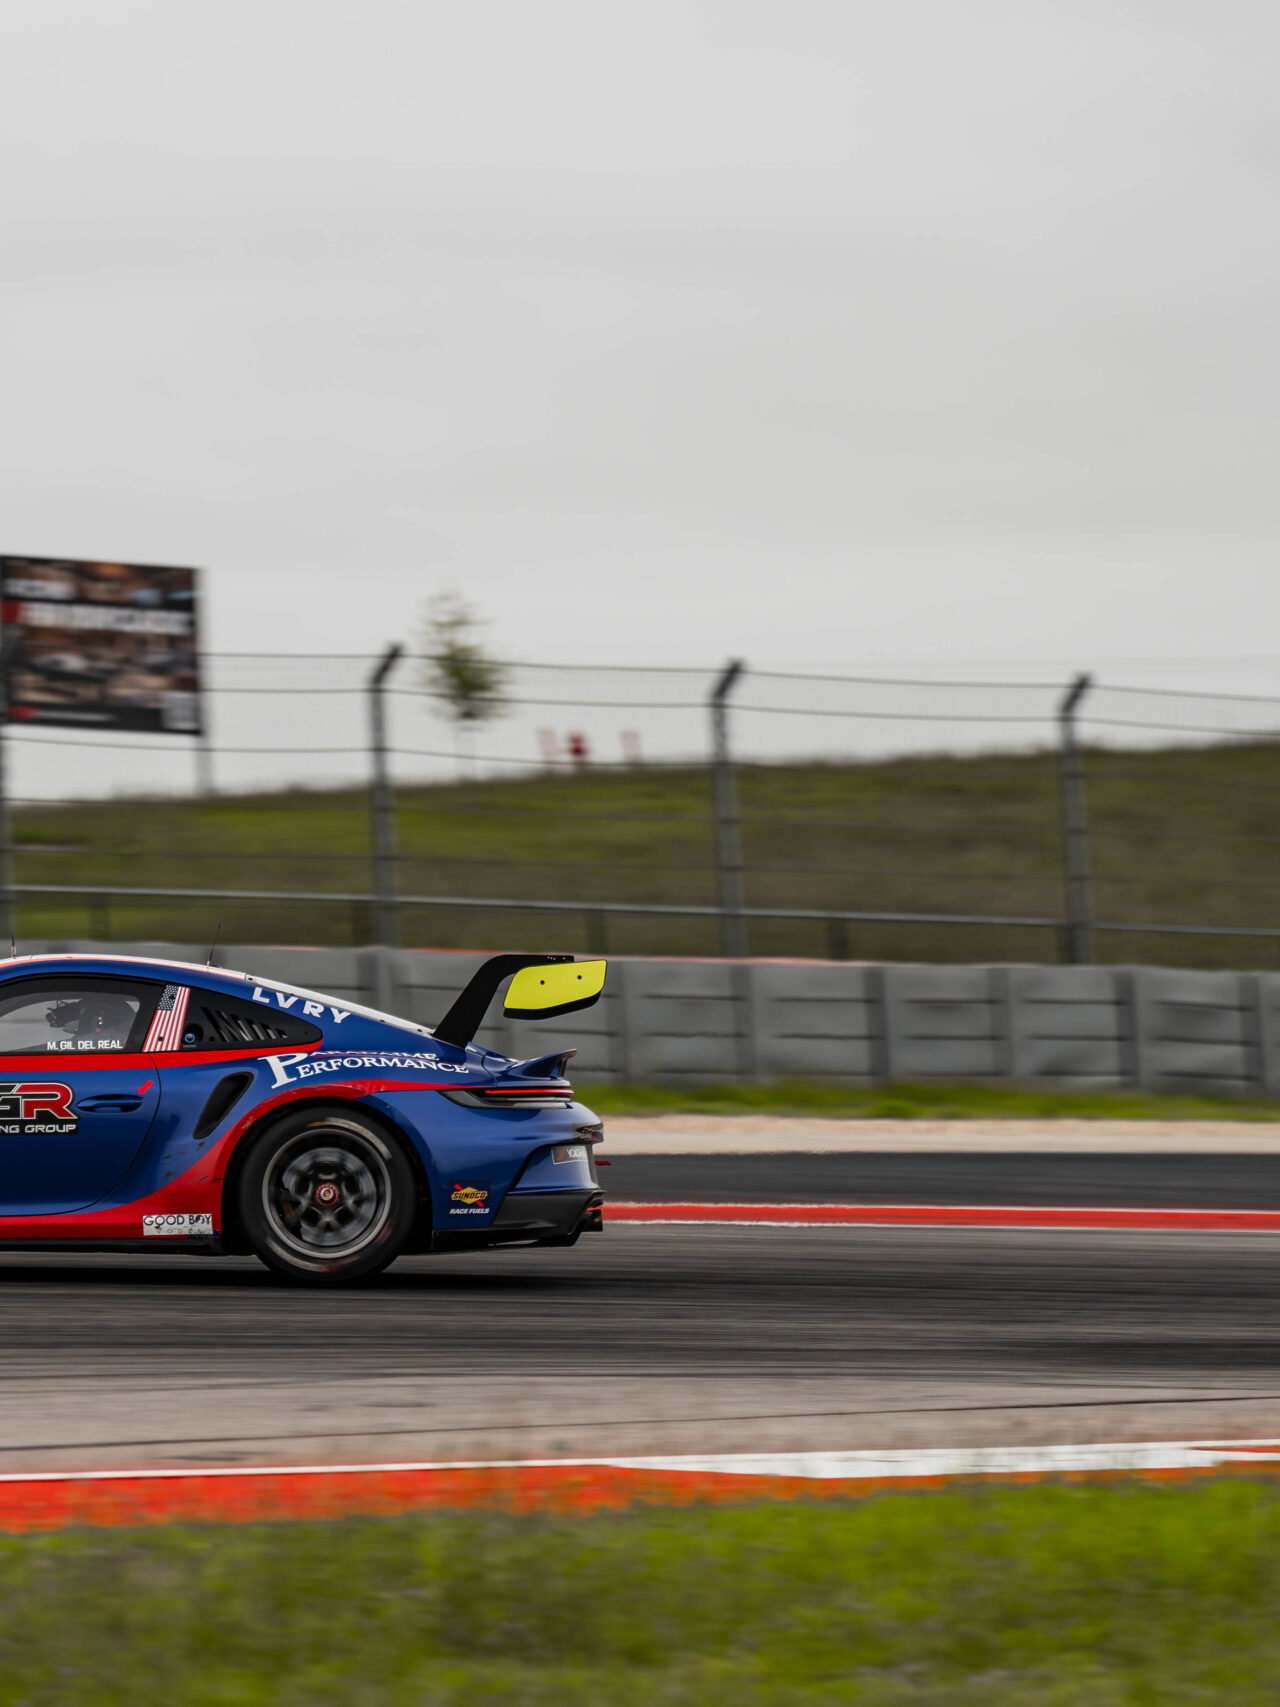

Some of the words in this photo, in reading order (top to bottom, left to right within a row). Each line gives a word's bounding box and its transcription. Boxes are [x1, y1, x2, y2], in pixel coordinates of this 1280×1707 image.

[252, 987, 352, 1024] LVRY
[60, 1041, 75, 1050] GIL
[78, 1041, 96, 1050] DEL
[98, 1040, 123, 1049] REAL
[257, 1052, 469, 1089] PERFORMANCE
[24, 1124, 76, 1133] GROUP
[453, 1191, 486, 1200] SUNOCO
[469, 1207, 490, 1215] FUELS
[143, 1215, 185, 1226] GOOD
[188, 1214, 212, 1225] BOY
